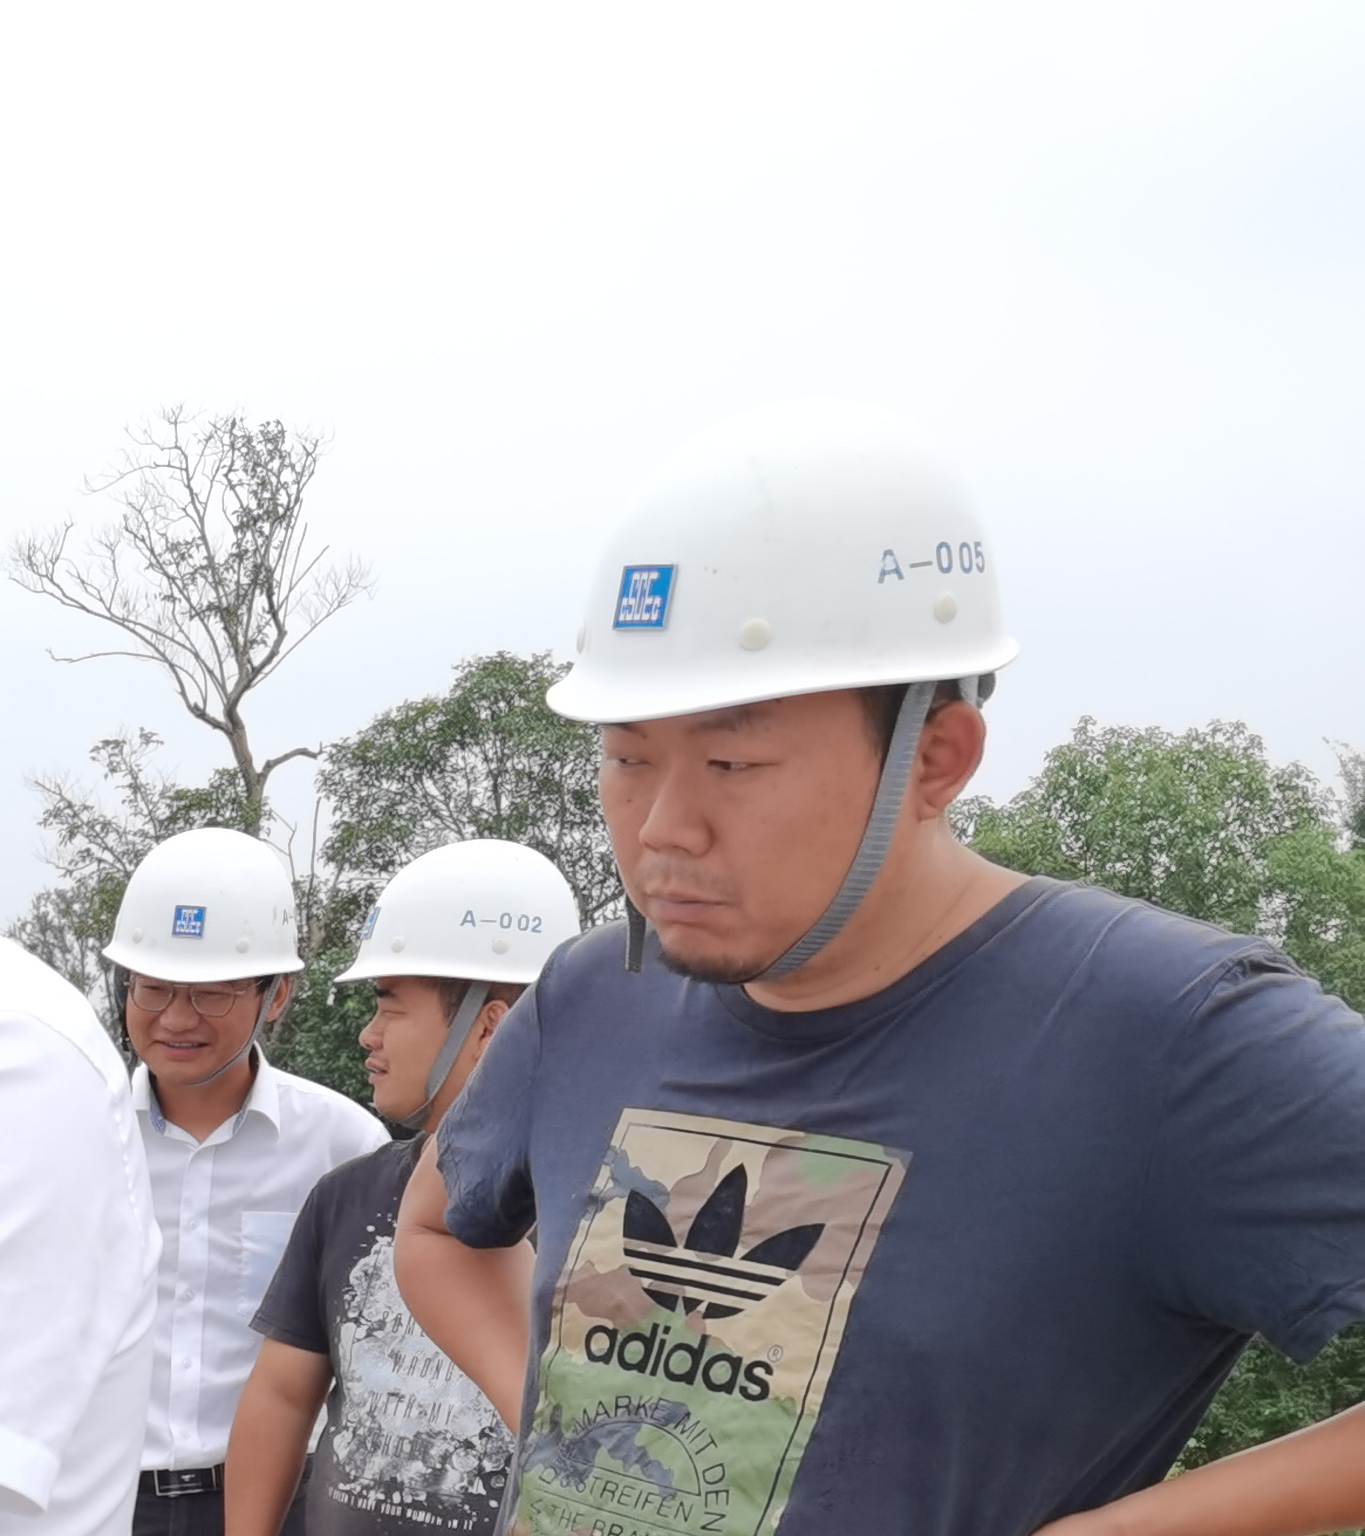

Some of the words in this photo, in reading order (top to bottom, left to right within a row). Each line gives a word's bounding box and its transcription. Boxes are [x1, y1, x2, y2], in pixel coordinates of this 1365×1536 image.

[877, 540, 986, 584] A-005
[459, 909, 543, 934] A-002
[584, 1322, 774, 1402] adidas
[572, 1394, 671, 1436] MARKE
[673, 1411, 719, 1456] MIT
[700, 1462, 730, 1533] DEN
[550, 1503, 585, 1533] THE
